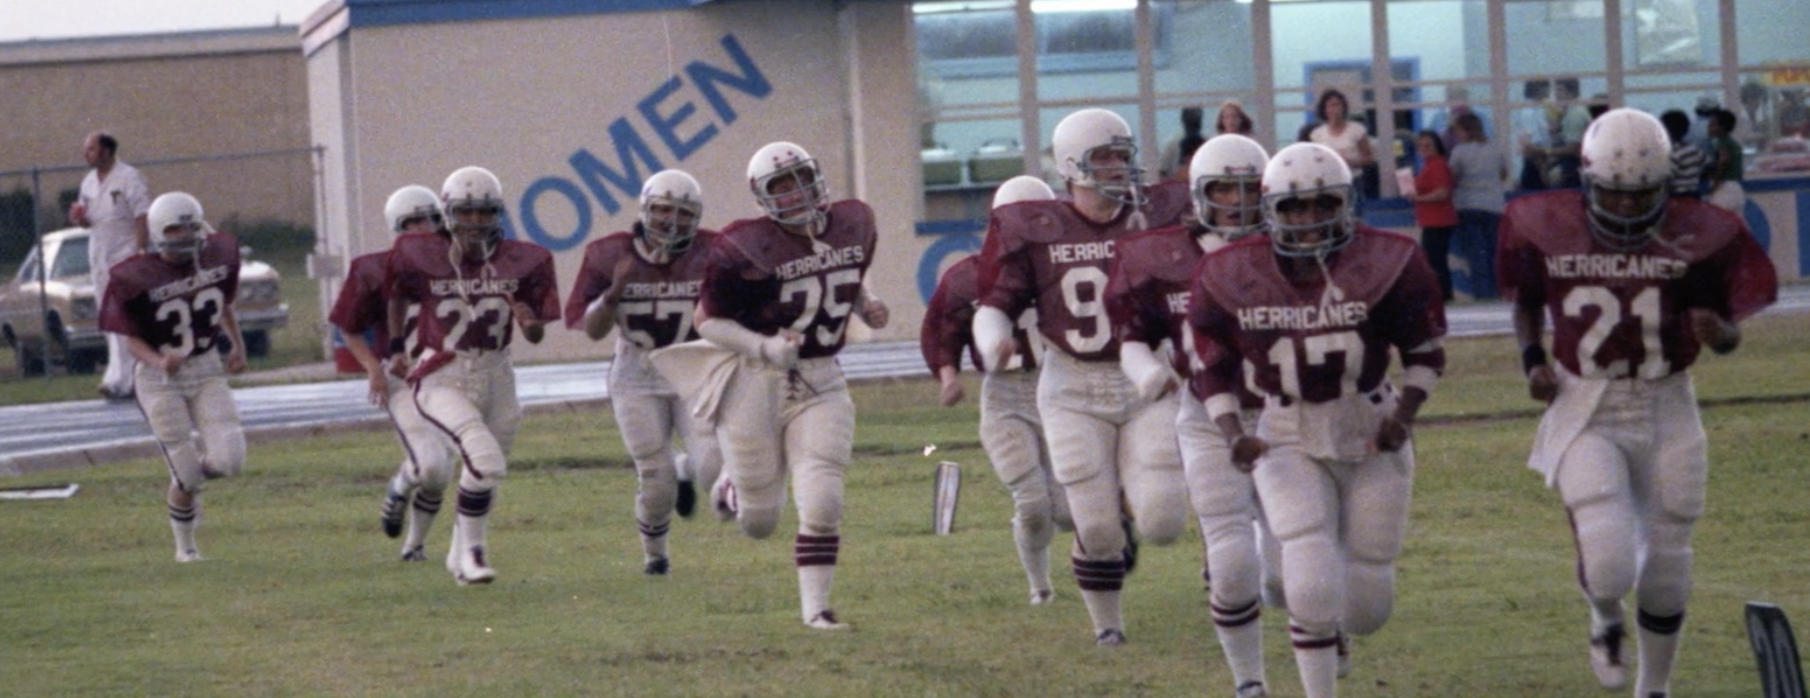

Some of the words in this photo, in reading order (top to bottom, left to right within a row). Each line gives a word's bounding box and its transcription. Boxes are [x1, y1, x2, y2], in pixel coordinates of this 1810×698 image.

[500, 33, 773, 252] OMEN
[775, 245, 864, 280] HERRICANES
[1048, 240, 1115, 263] HERRIC
[1544, 255, 1688, 279] HERRICANES
[430, 279, 518, 296] HERRICANES
[620, 280, 704, 299] ERRICANE
[780, 268, 861, 347] 75
[1061, 266, 1112, 353] 9
[156, 287, 224, 357] 33
[436, 298, 510, 354] 23
[617, 301, 693, 349] 57
[1237, 303, 1368, 330] HERRICANES
[1562, 286, 1671, 379] 21
[1268, 331, 1364, 399] 17
